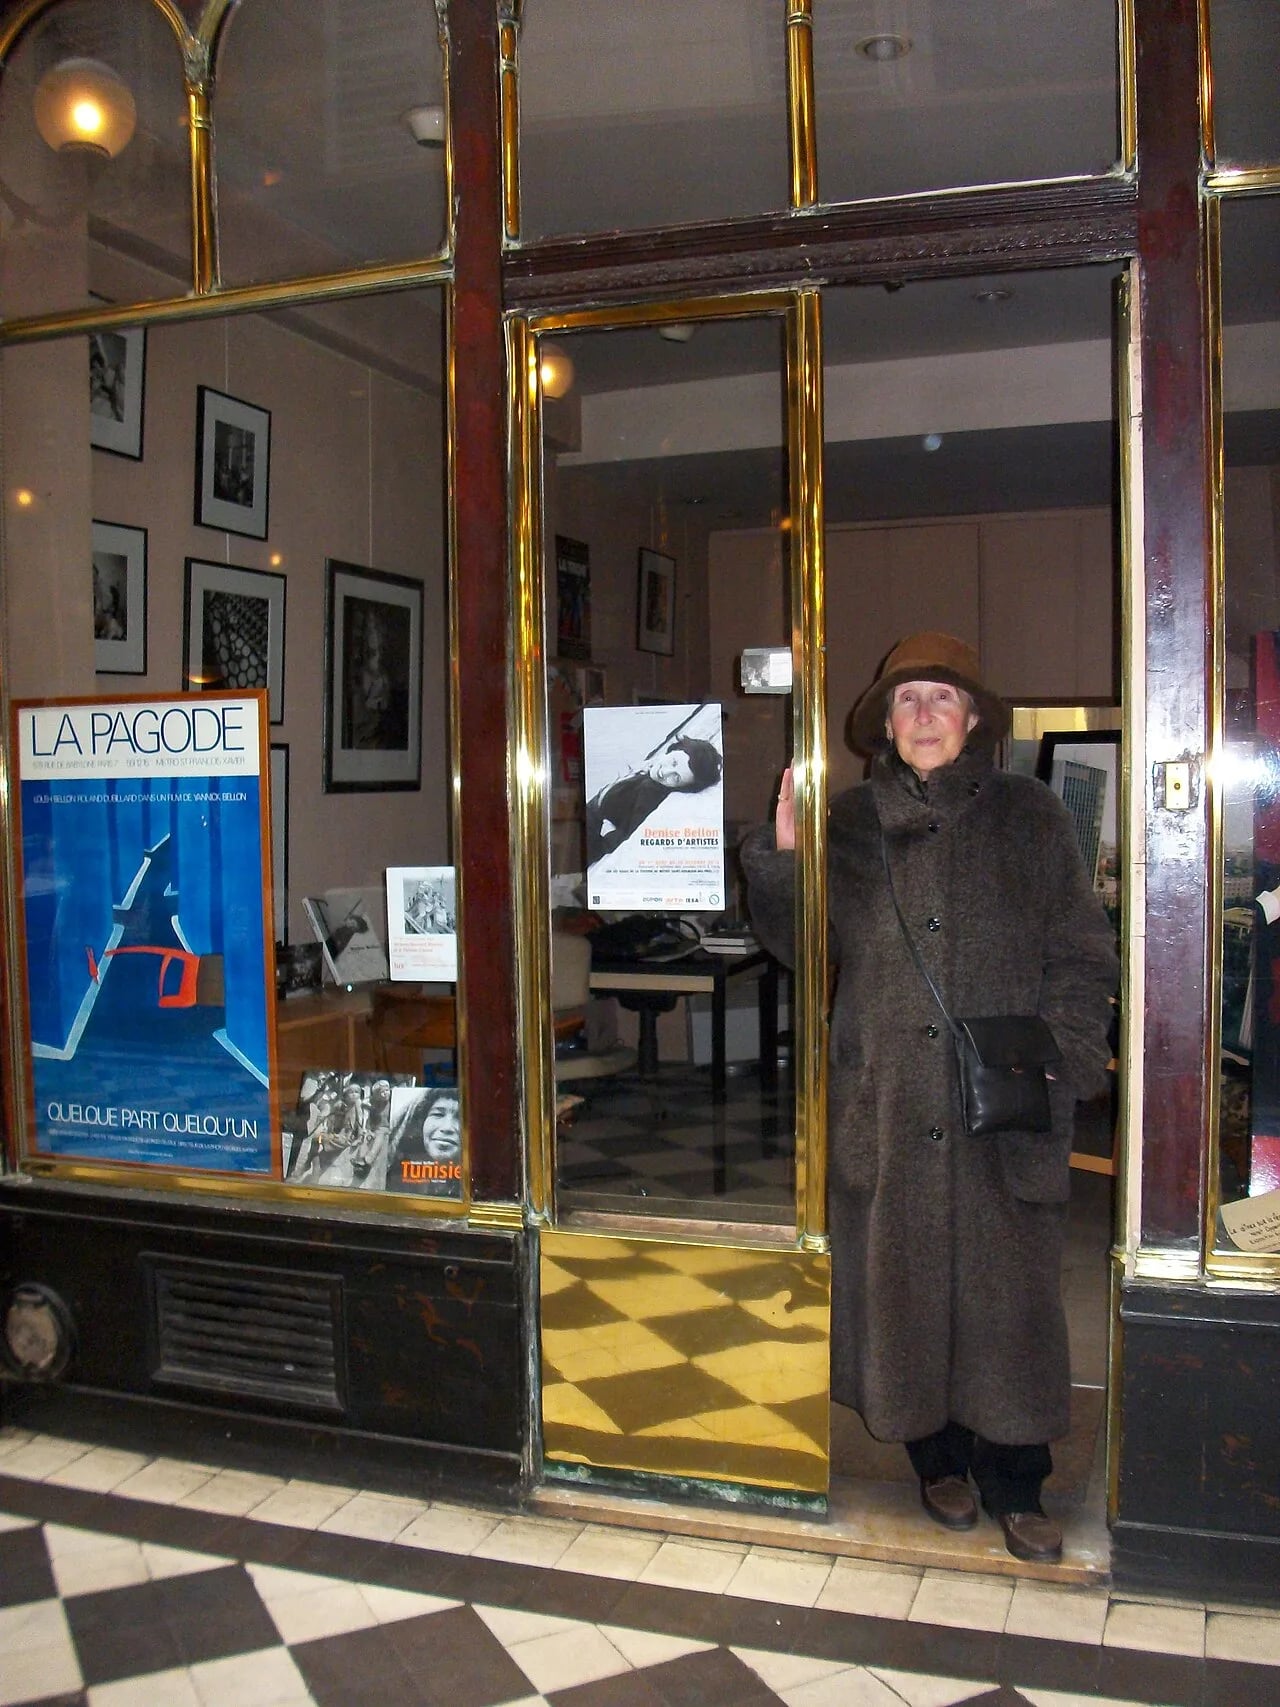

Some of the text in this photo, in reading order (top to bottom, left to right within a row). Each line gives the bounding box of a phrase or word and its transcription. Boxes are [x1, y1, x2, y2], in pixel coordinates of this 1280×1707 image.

[31, 706, 245, 756] LA PAGODE
[640, 838, 719, 846] REGARDS D'ARTISTES
[644, 827, 719, 838] Denise Bellon
[47, 1102, 119, 1127] QUELQUE
[121, 1108, 160, 1131] PART
[162, 1112, 258, 1140] QUELQU'UN
[401, 1160, 463, 1180] Tunisie
